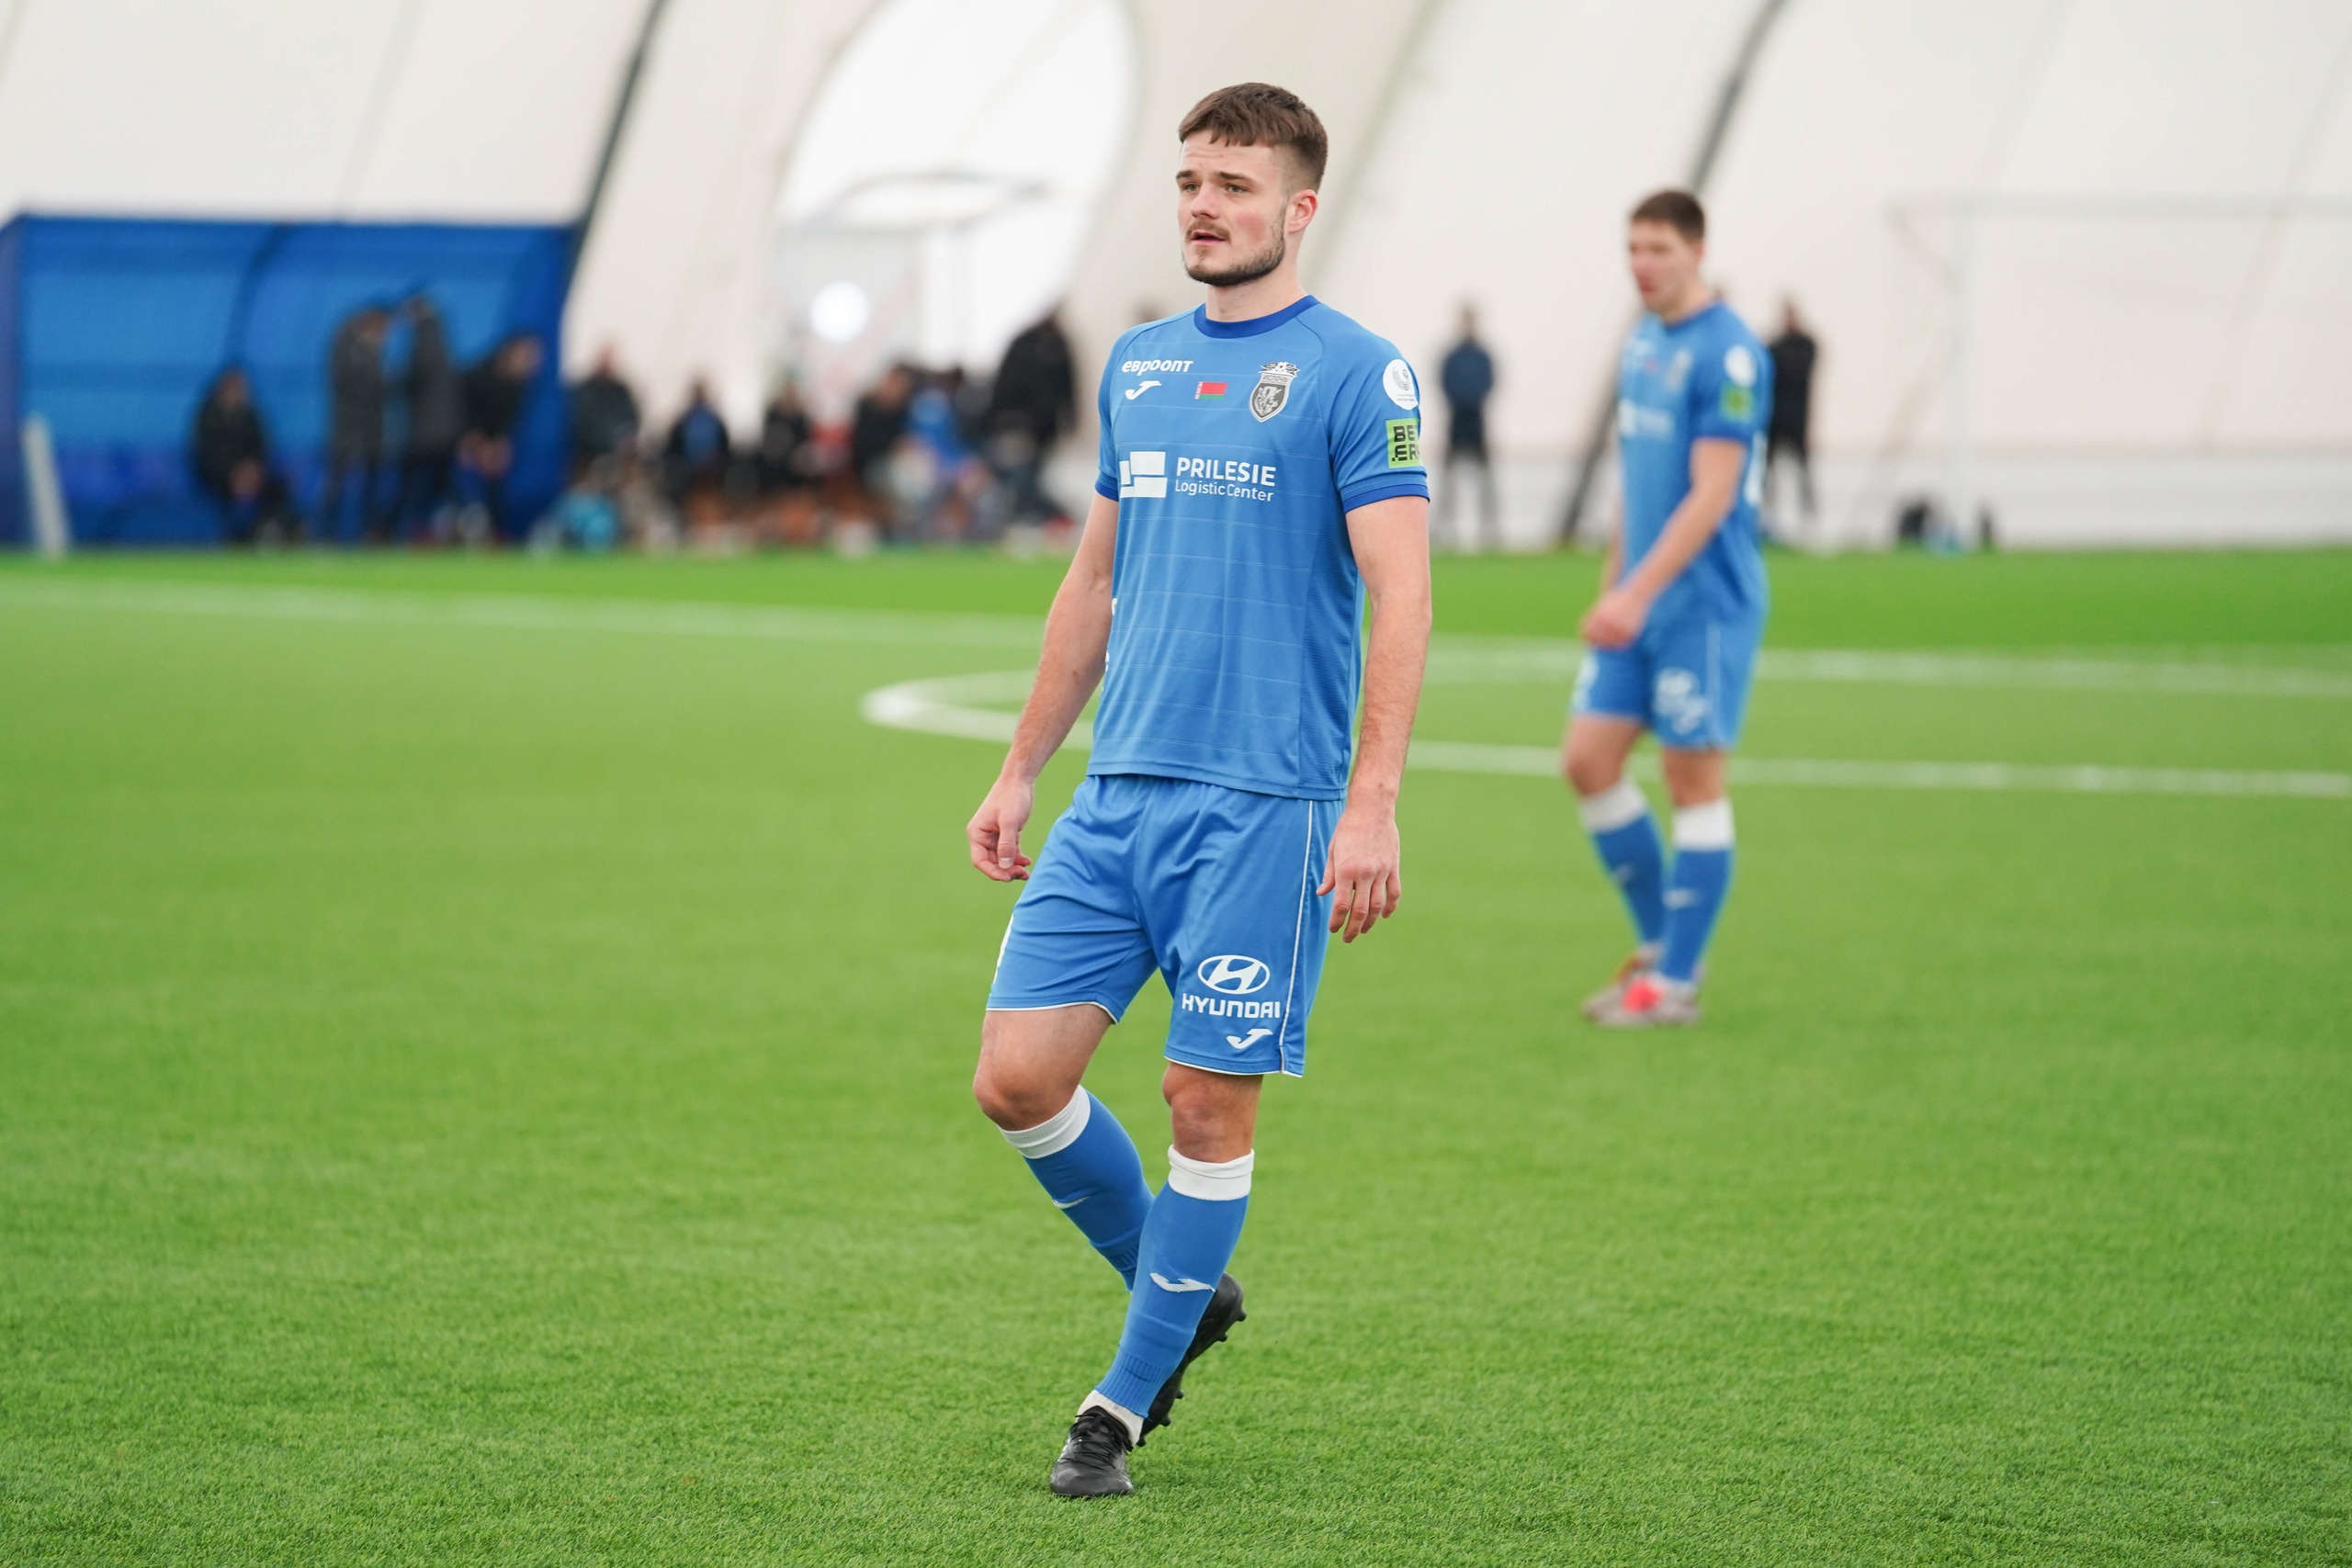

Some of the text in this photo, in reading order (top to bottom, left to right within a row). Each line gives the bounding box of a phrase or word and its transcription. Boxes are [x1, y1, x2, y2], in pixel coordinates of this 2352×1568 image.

[1122, 359, 1193, 376] евроопт
[1177, 457, 1276, 487] PRILESIE
[1175, 479, 1274, 502] Logistic Center
[1182, 993, 1281, 1019] HYUNDAI
